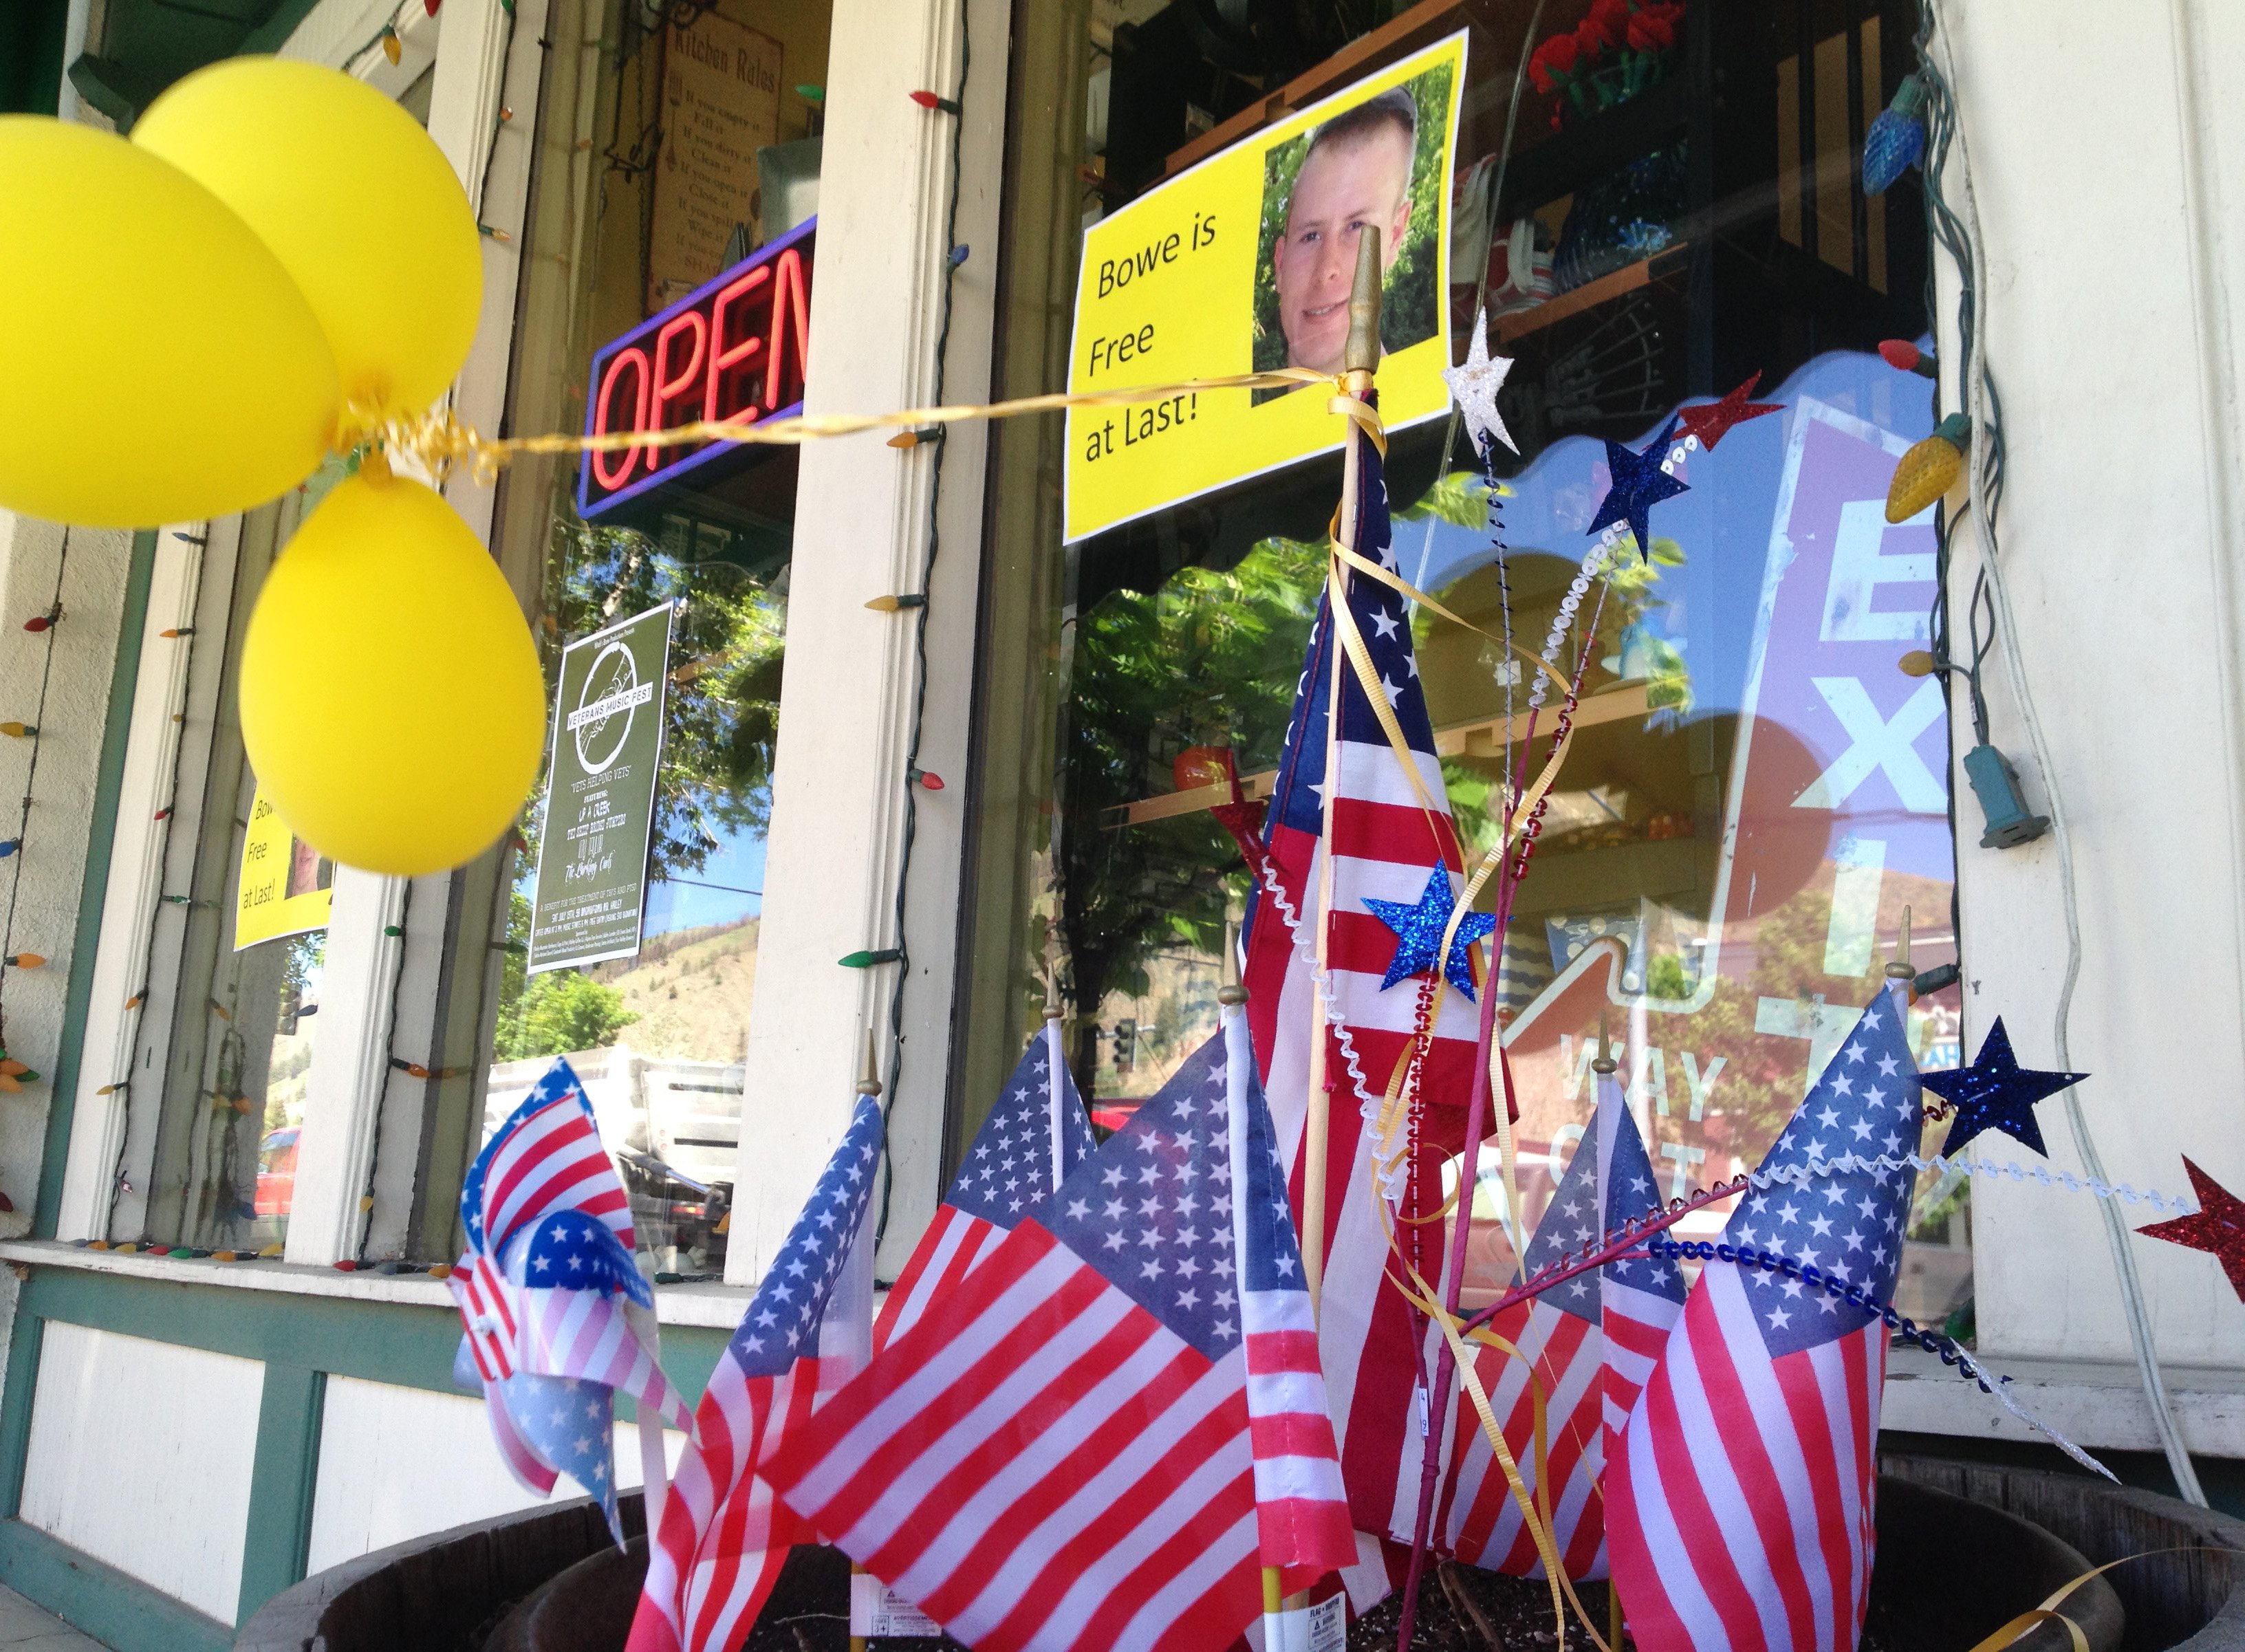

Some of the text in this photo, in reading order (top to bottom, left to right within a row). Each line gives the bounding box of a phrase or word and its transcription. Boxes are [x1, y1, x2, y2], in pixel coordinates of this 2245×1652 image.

[737, 47, 774, 94] Rules
[1098, 212, 1216, 300] Bowe is
[592, 248, 810, 491] OPEN
[1089, 323, 1154, 377] Free
[1085, 380, 1197, 462] at Last!
[568, 687, 653, 728] VETERANS MUSIC FEST
[587, 770, 612, 789] HELPING
[255, 800, 276, 820] Bow
[587, 805, 592, 818] A
[248, 841, 268, 863] Free
[243, 878, 275, 909] at Last!
[1560, 1034, 1728, 1122] WAY
